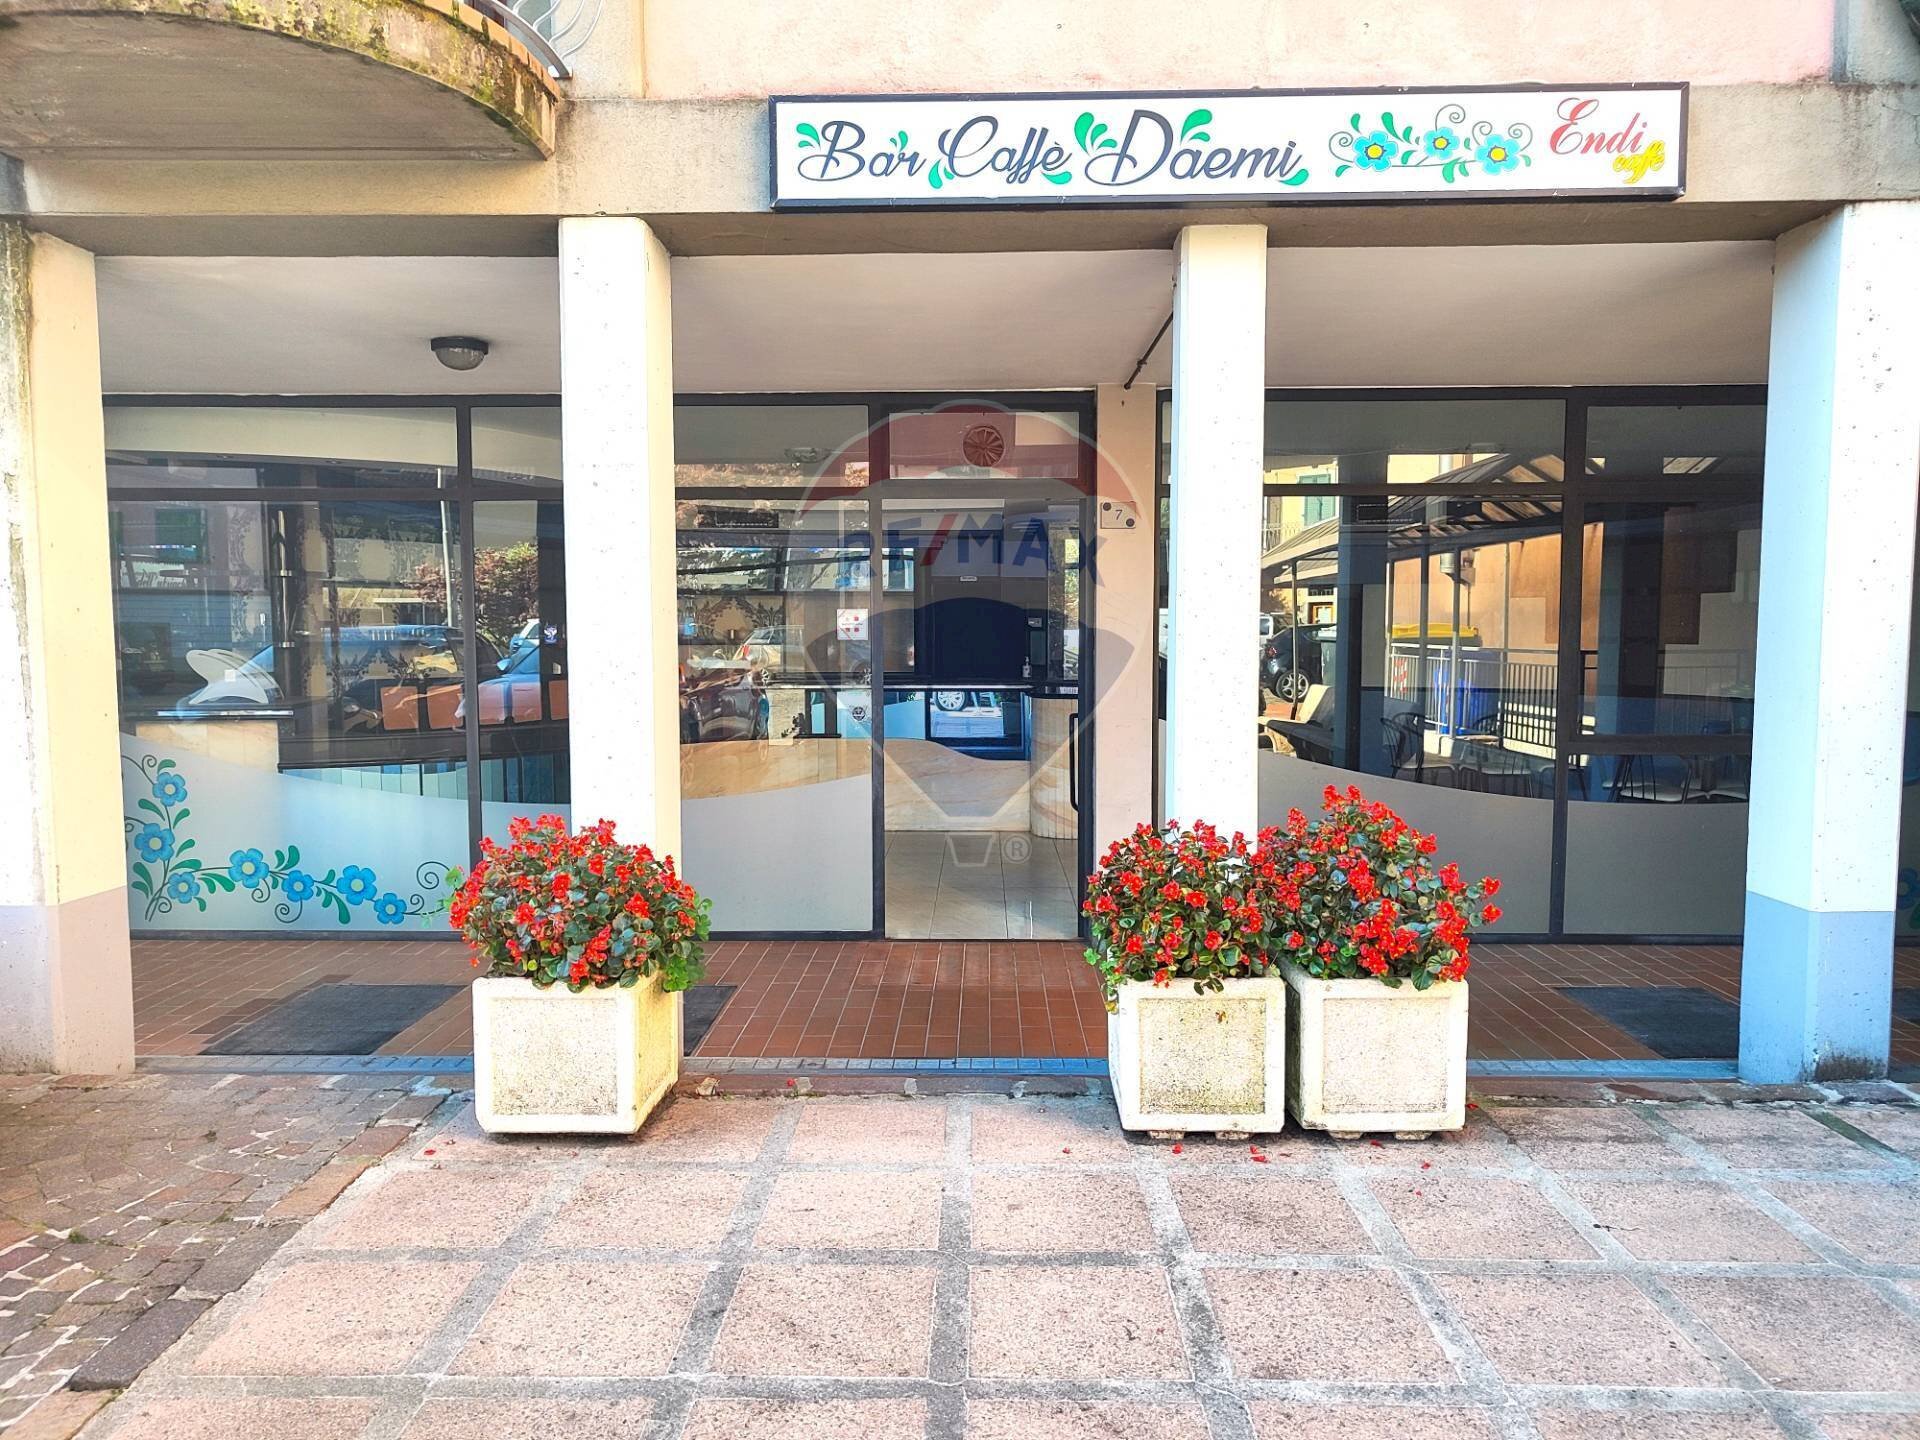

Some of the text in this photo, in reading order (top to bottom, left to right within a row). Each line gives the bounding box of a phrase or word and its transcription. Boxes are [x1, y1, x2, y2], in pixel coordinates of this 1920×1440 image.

[798, 109, 1302, 186] Bar Caffè Daemi
[1550, 97, 1648, 155] Endi
[1115, 509, 1123, 521] 7
